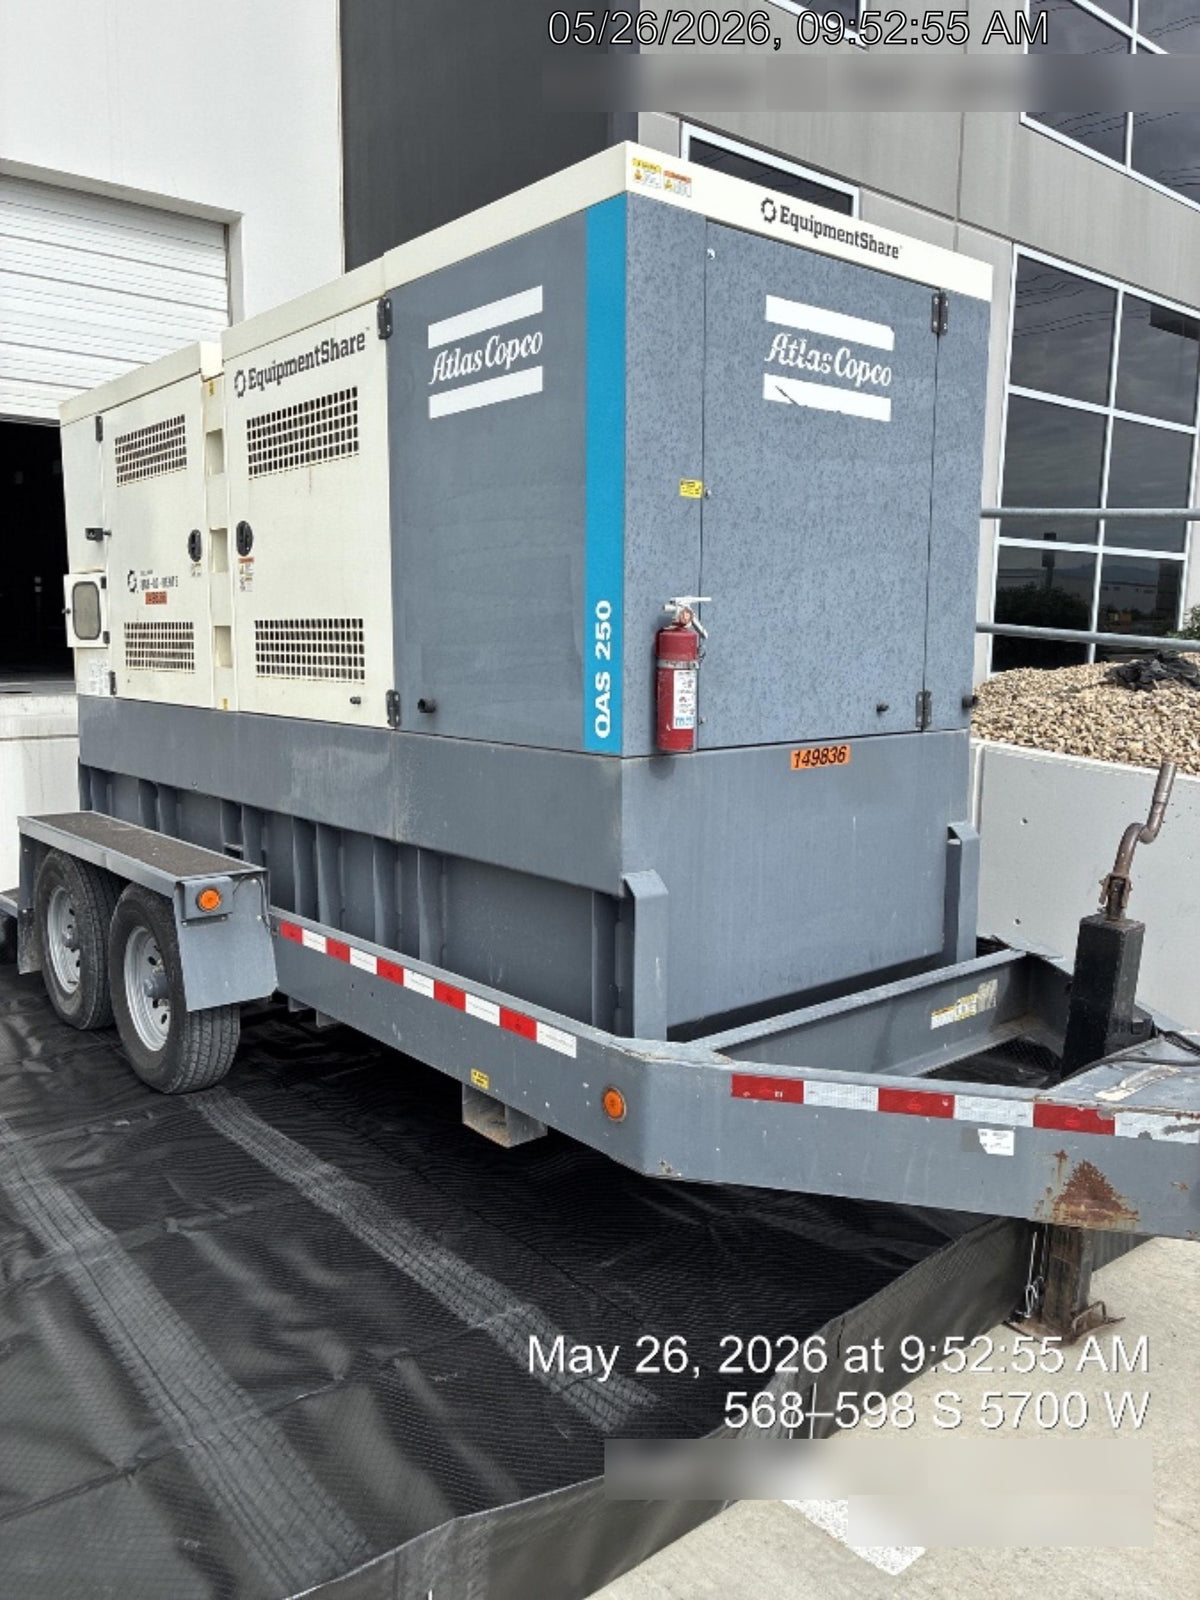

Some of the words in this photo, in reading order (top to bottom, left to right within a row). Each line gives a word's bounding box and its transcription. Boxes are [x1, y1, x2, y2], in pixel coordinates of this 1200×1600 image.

[779, 204, 900, 259] EquipmentShare
[247, 330, 366, 390] EquipmentShare
[594, 600, 612, 661] 250
[794, 745, 848, 769] 149836
